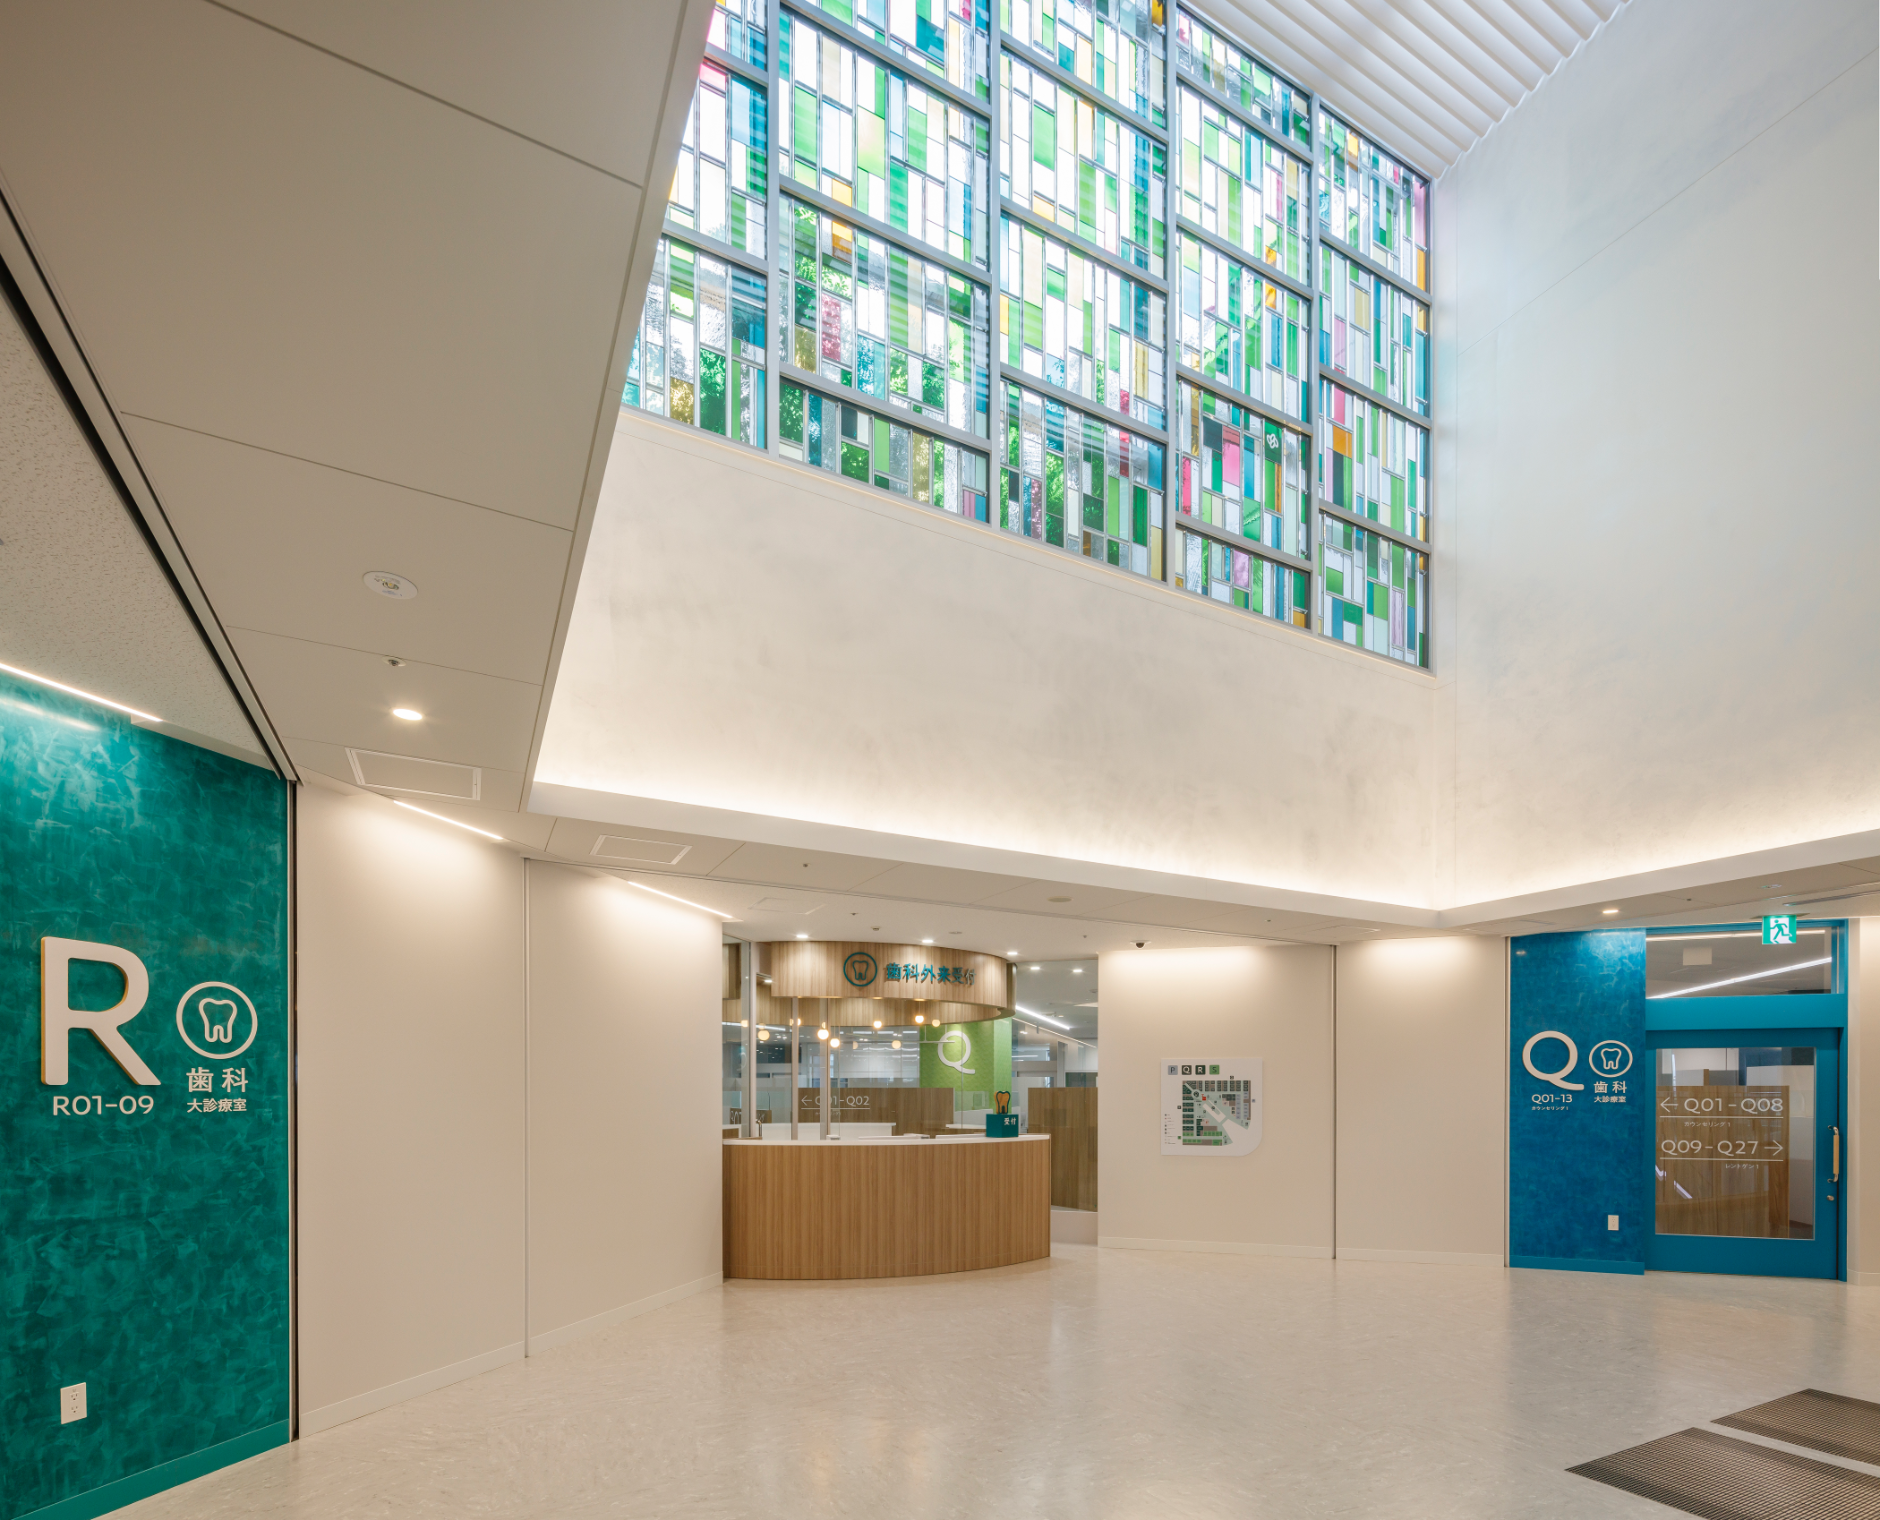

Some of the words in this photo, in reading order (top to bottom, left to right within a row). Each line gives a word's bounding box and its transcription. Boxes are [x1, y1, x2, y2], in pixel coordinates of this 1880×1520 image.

[886, 962, 976, 985] 歯科外来受付
[41, 936, 161, 1085] R
[937, 1030, 976, 1075] Q
[1522, 1030, 1585, 1091] Q
[186, 1067, 249, 1093] 歯科
[53, 1095, 154, 1116] R01-09
[187, 1098, 247, 1113] 大診療室
[1531, 1094, 1573, 1104] Q01-13
